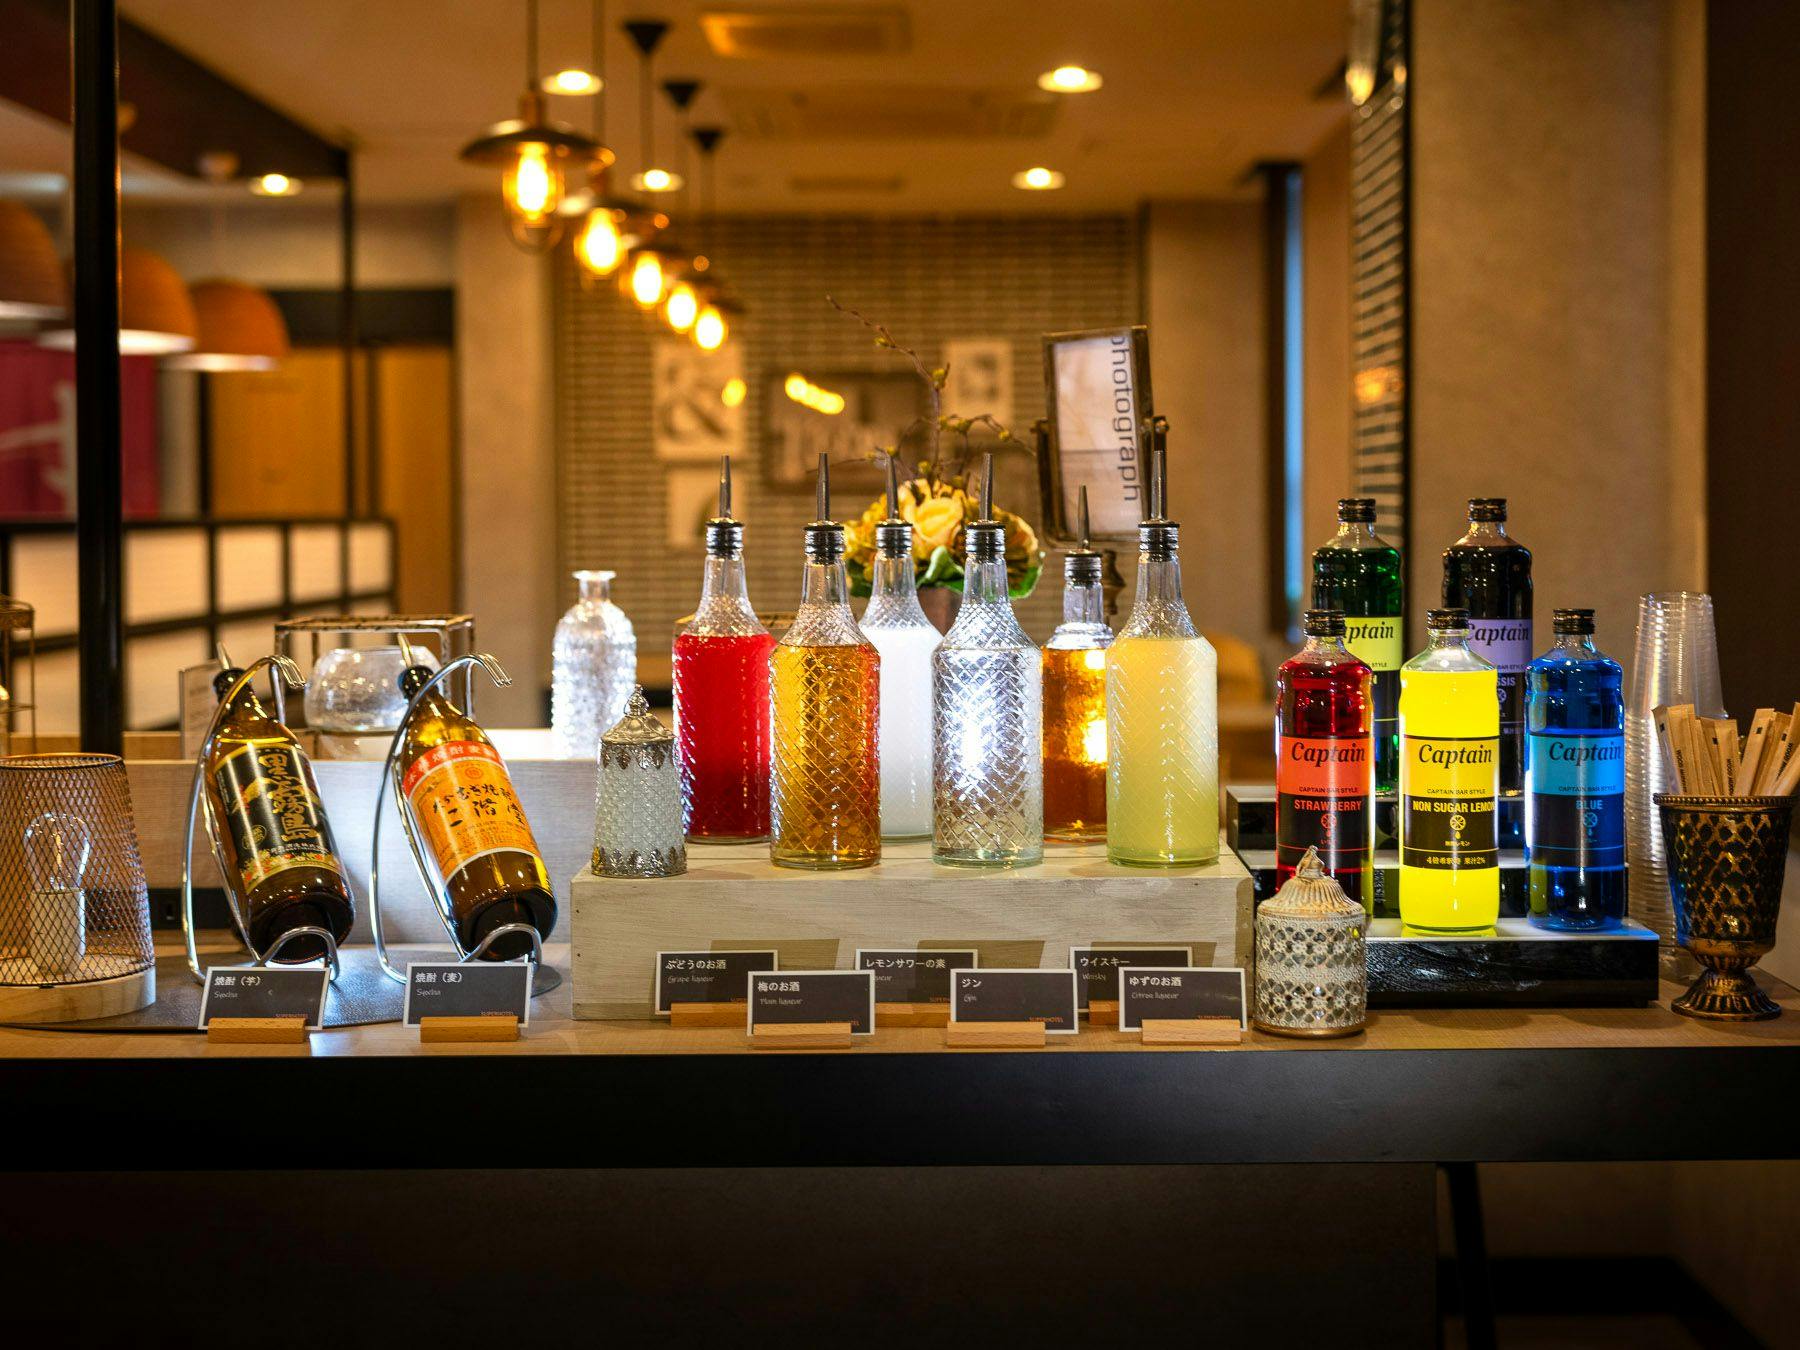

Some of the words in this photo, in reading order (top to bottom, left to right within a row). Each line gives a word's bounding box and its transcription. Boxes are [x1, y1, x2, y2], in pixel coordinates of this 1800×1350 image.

[1344, 621, 1393, 644] ptain
[1291, 742, 1365, 767] Captain
[1419, 744, 1492, 769] Captain
[1549, 741, 1622, 766] Captain
[1293, 799, 1362, 811] STRAWBERRY
[1412, 800, 1431, 812] NON
[1433, 801, 1468, 813] SUGAR
[1576, 799, 1604, 810] BLUE
[665, 958, 727, 970] ぶどうのお酒
[866, 958, 946, 969] レモンサワーの素
[1080, 957, 1131, 967] ウイスキー
[757, 981, 800, 992] 梅のお酒
[961, 978, 982, 988] ジン
[1129, 976, 1182, 987] ゆずのお酒
